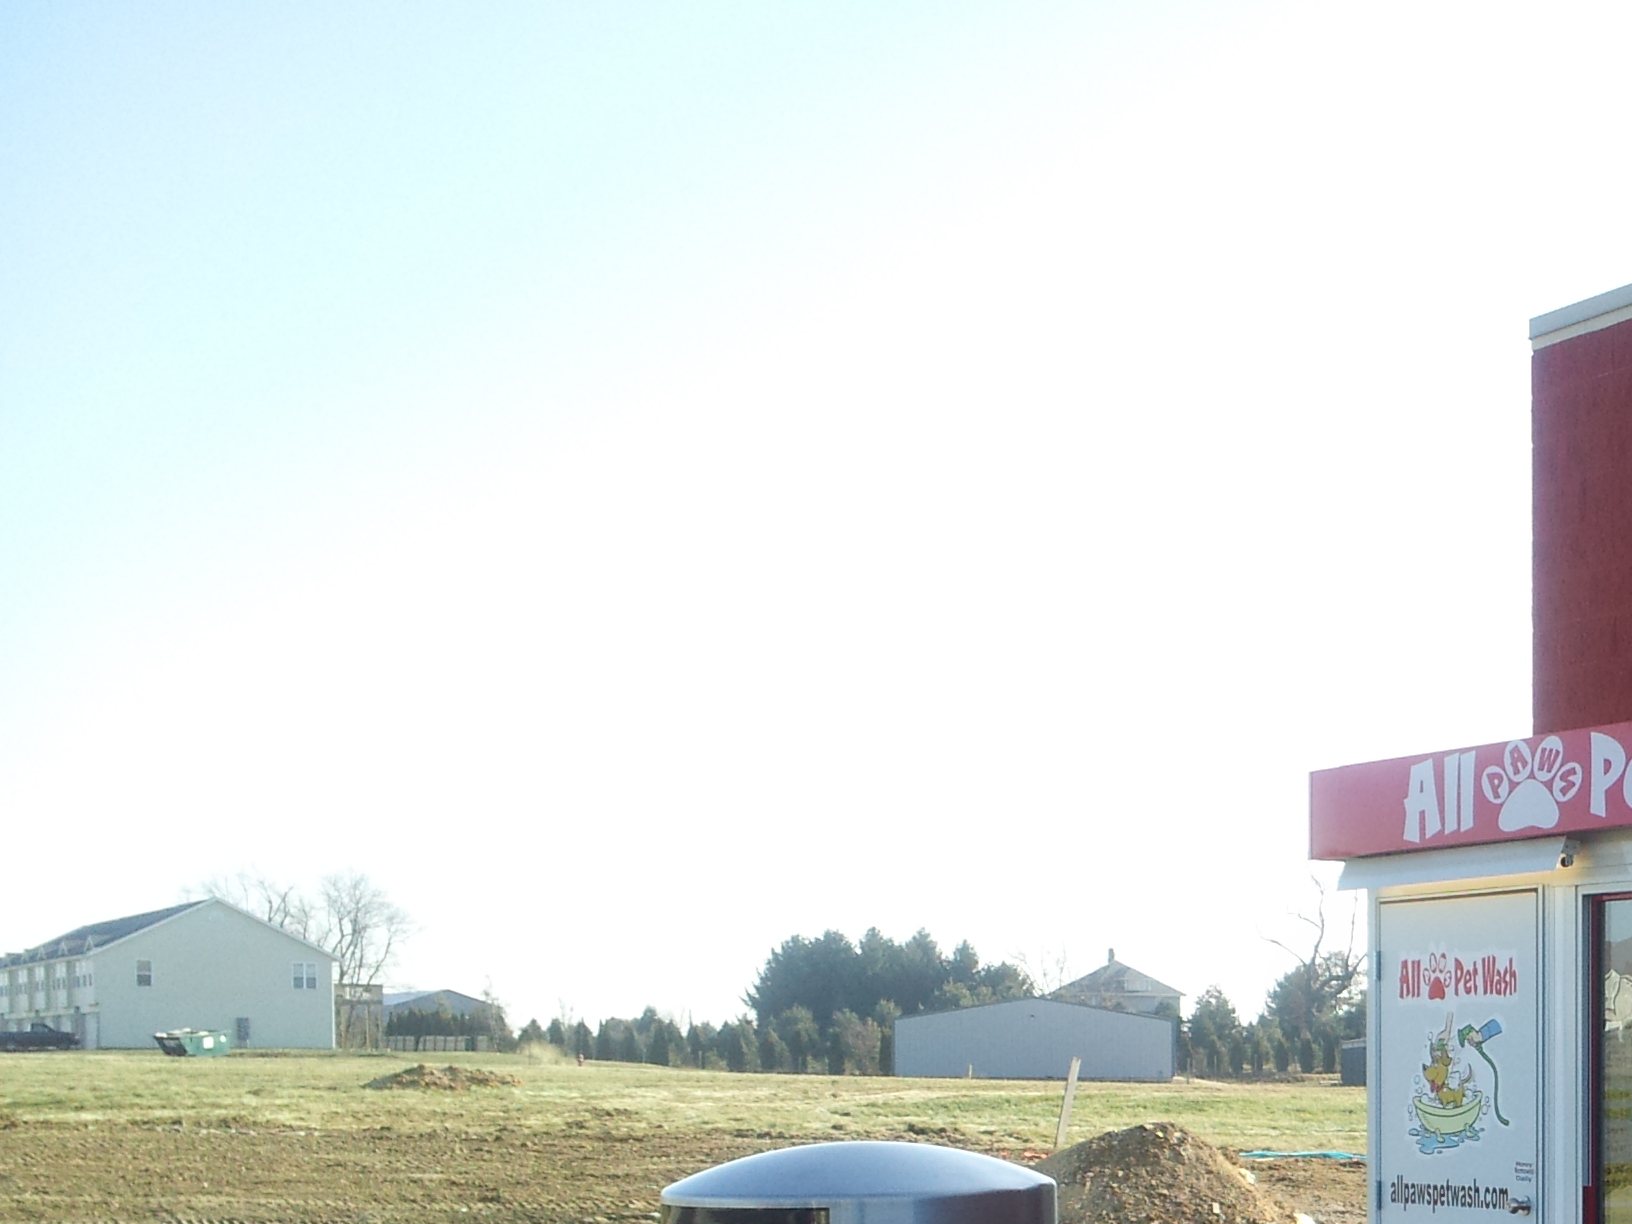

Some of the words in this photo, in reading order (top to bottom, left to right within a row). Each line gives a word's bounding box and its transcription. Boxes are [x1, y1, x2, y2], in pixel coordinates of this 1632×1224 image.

[1403, 750, 1476, 844] All
[1486, 743, 1577, 800] PAWS
[1399, 959, 1421, 999] All
[1454, 957, 1478, 997] Pet
[1481, 954, 1517, 998] Wash
[1390, 1174, 1509, 1214] allpawspetwash.com
